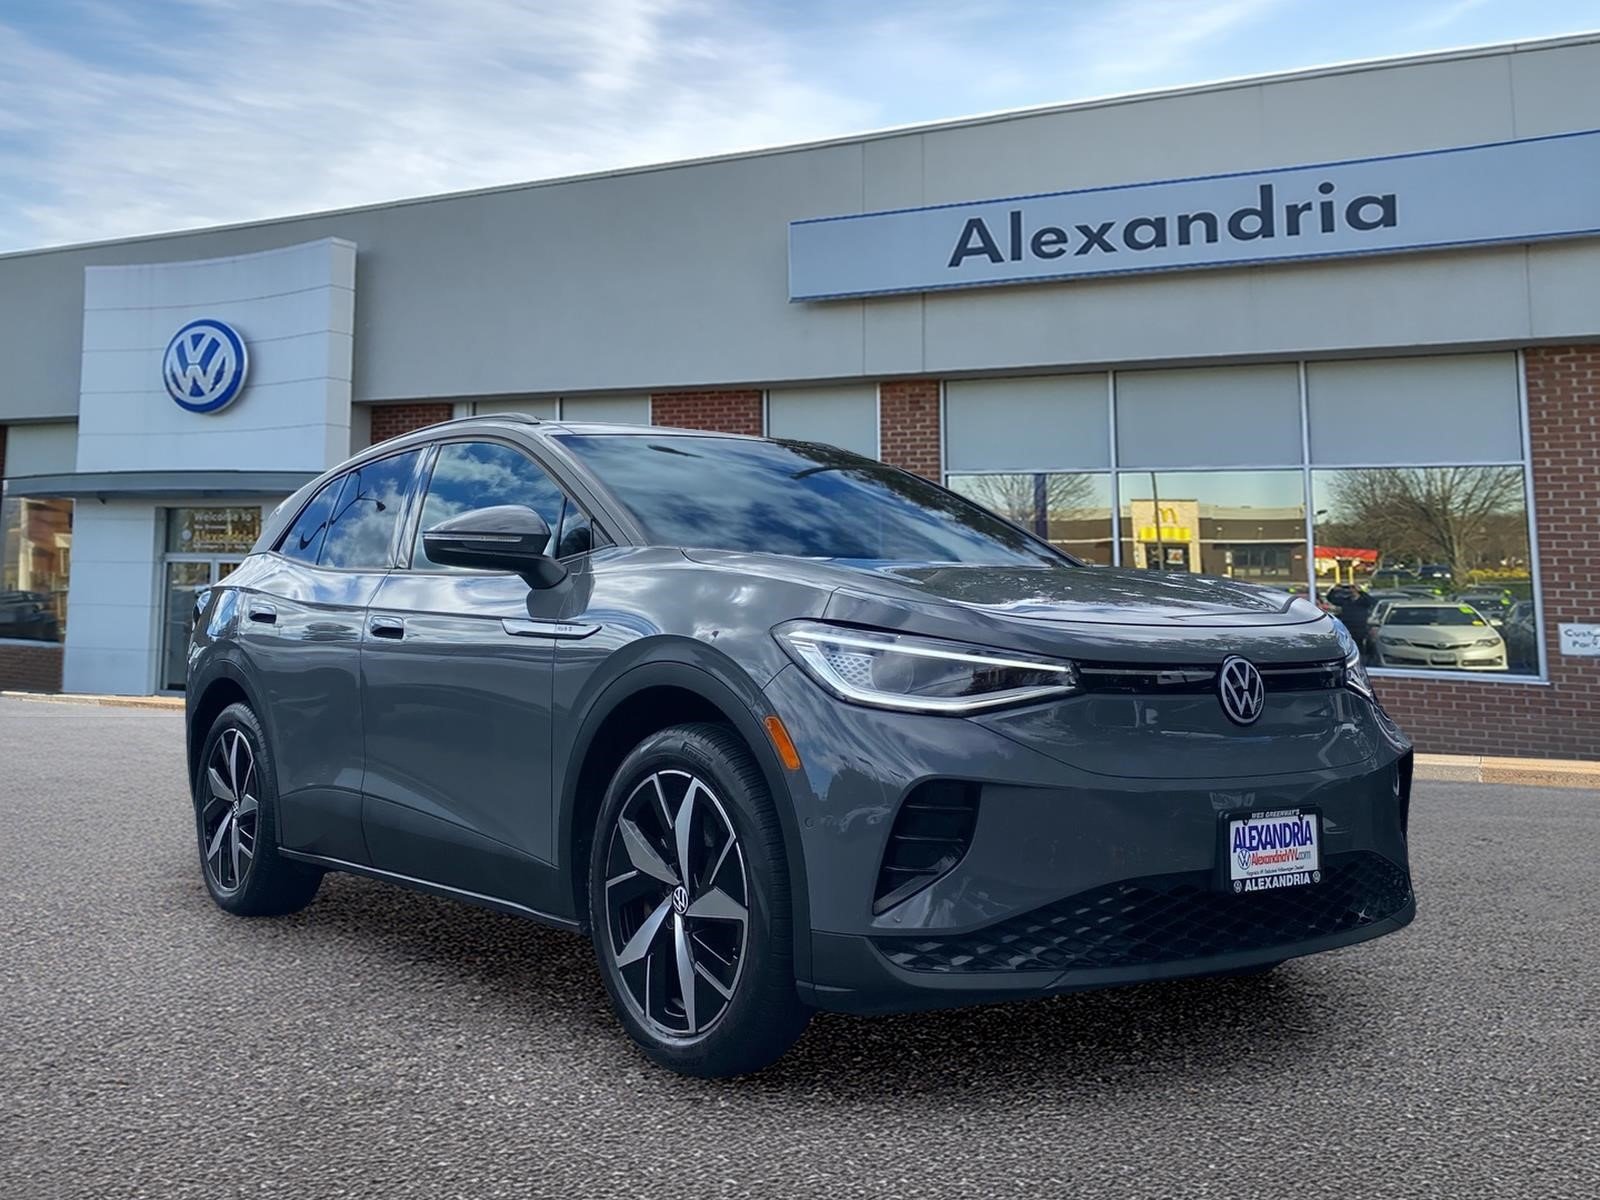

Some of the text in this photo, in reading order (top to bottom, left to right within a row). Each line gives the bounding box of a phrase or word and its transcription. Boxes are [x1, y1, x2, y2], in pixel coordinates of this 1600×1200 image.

[947, 182, 1397, 268] Alexandria
[165, 324, 240, 406] VW
[1222, 660, 1263, 721] VW
[1233, 820, 1313, 853] ALEXANDRIA
[1244, 872, 1310, 892] ALEXANDRIA
